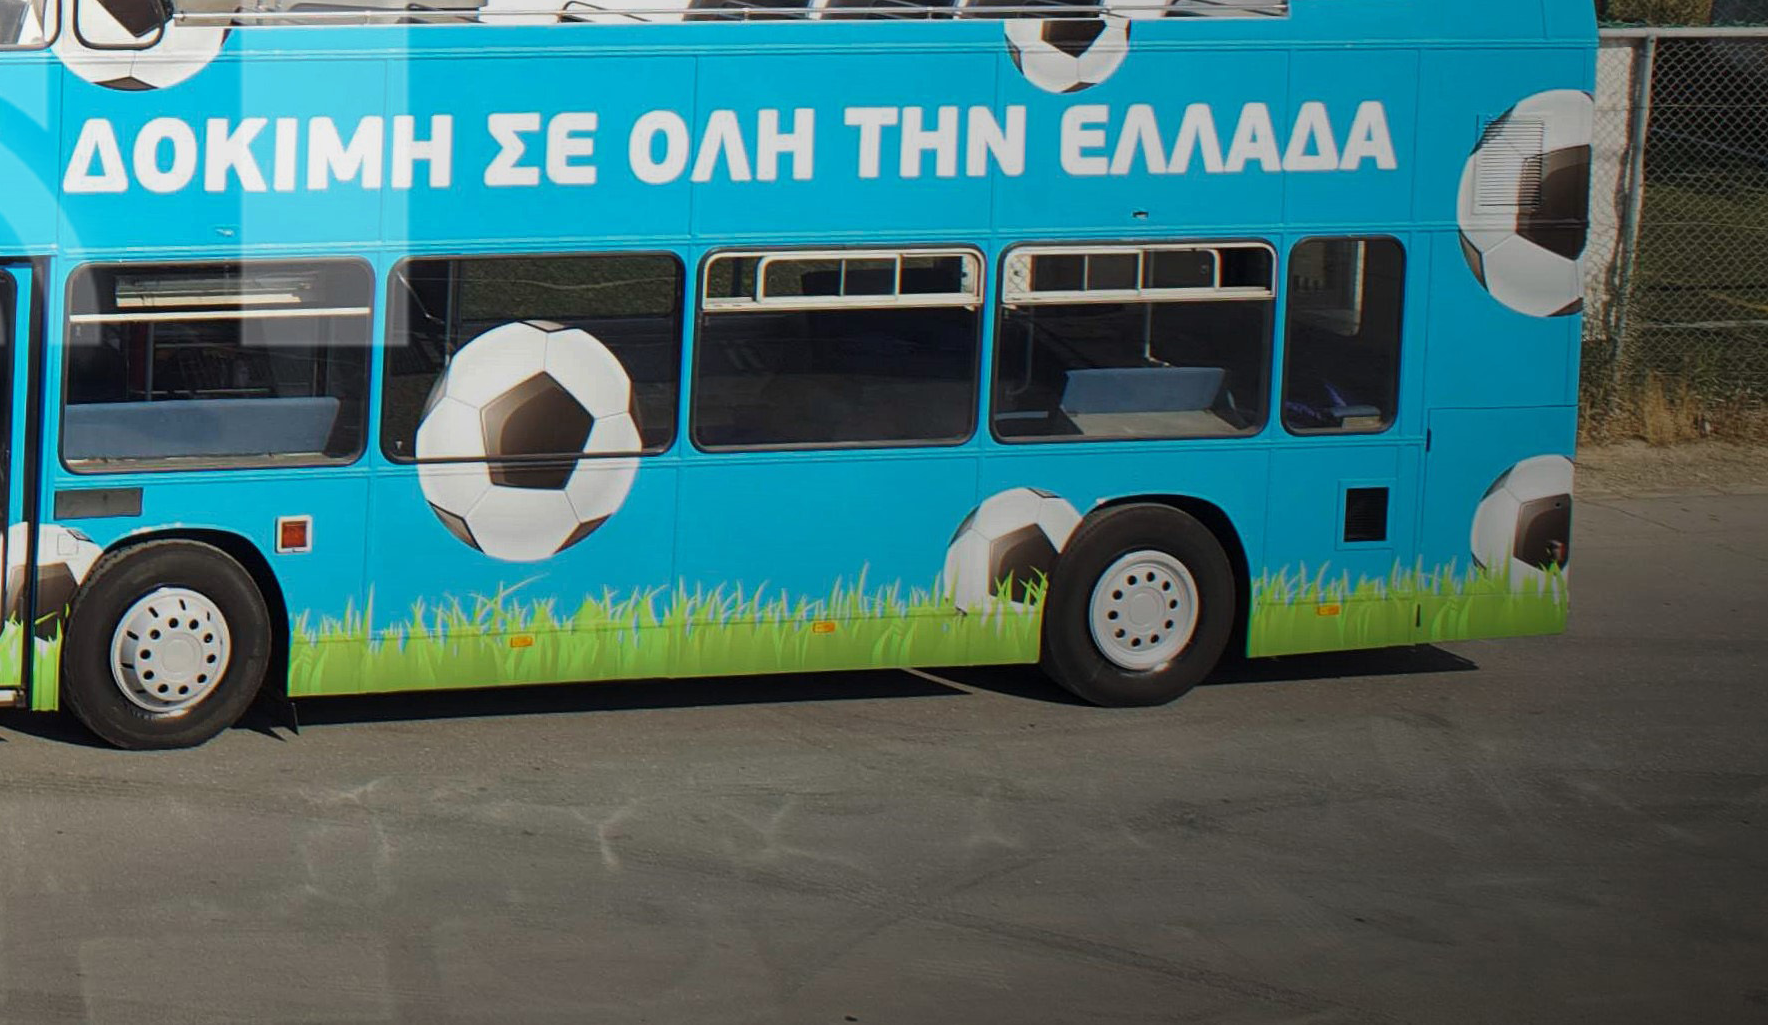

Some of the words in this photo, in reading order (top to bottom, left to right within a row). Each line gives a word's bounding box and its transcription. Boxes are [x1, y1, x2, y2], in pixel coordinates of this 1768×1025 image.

[63, 114, 454, 194] ΔΟΚΙΜΗ
[485, 112, 599, 186] ΣΕ
[628, 108, 815, 184] ΟΛΗ
[844, 105, 1027, 179] ΤΗΝ
[1061, 101, 1398, 176] ΕΛΛΑΔΑ
